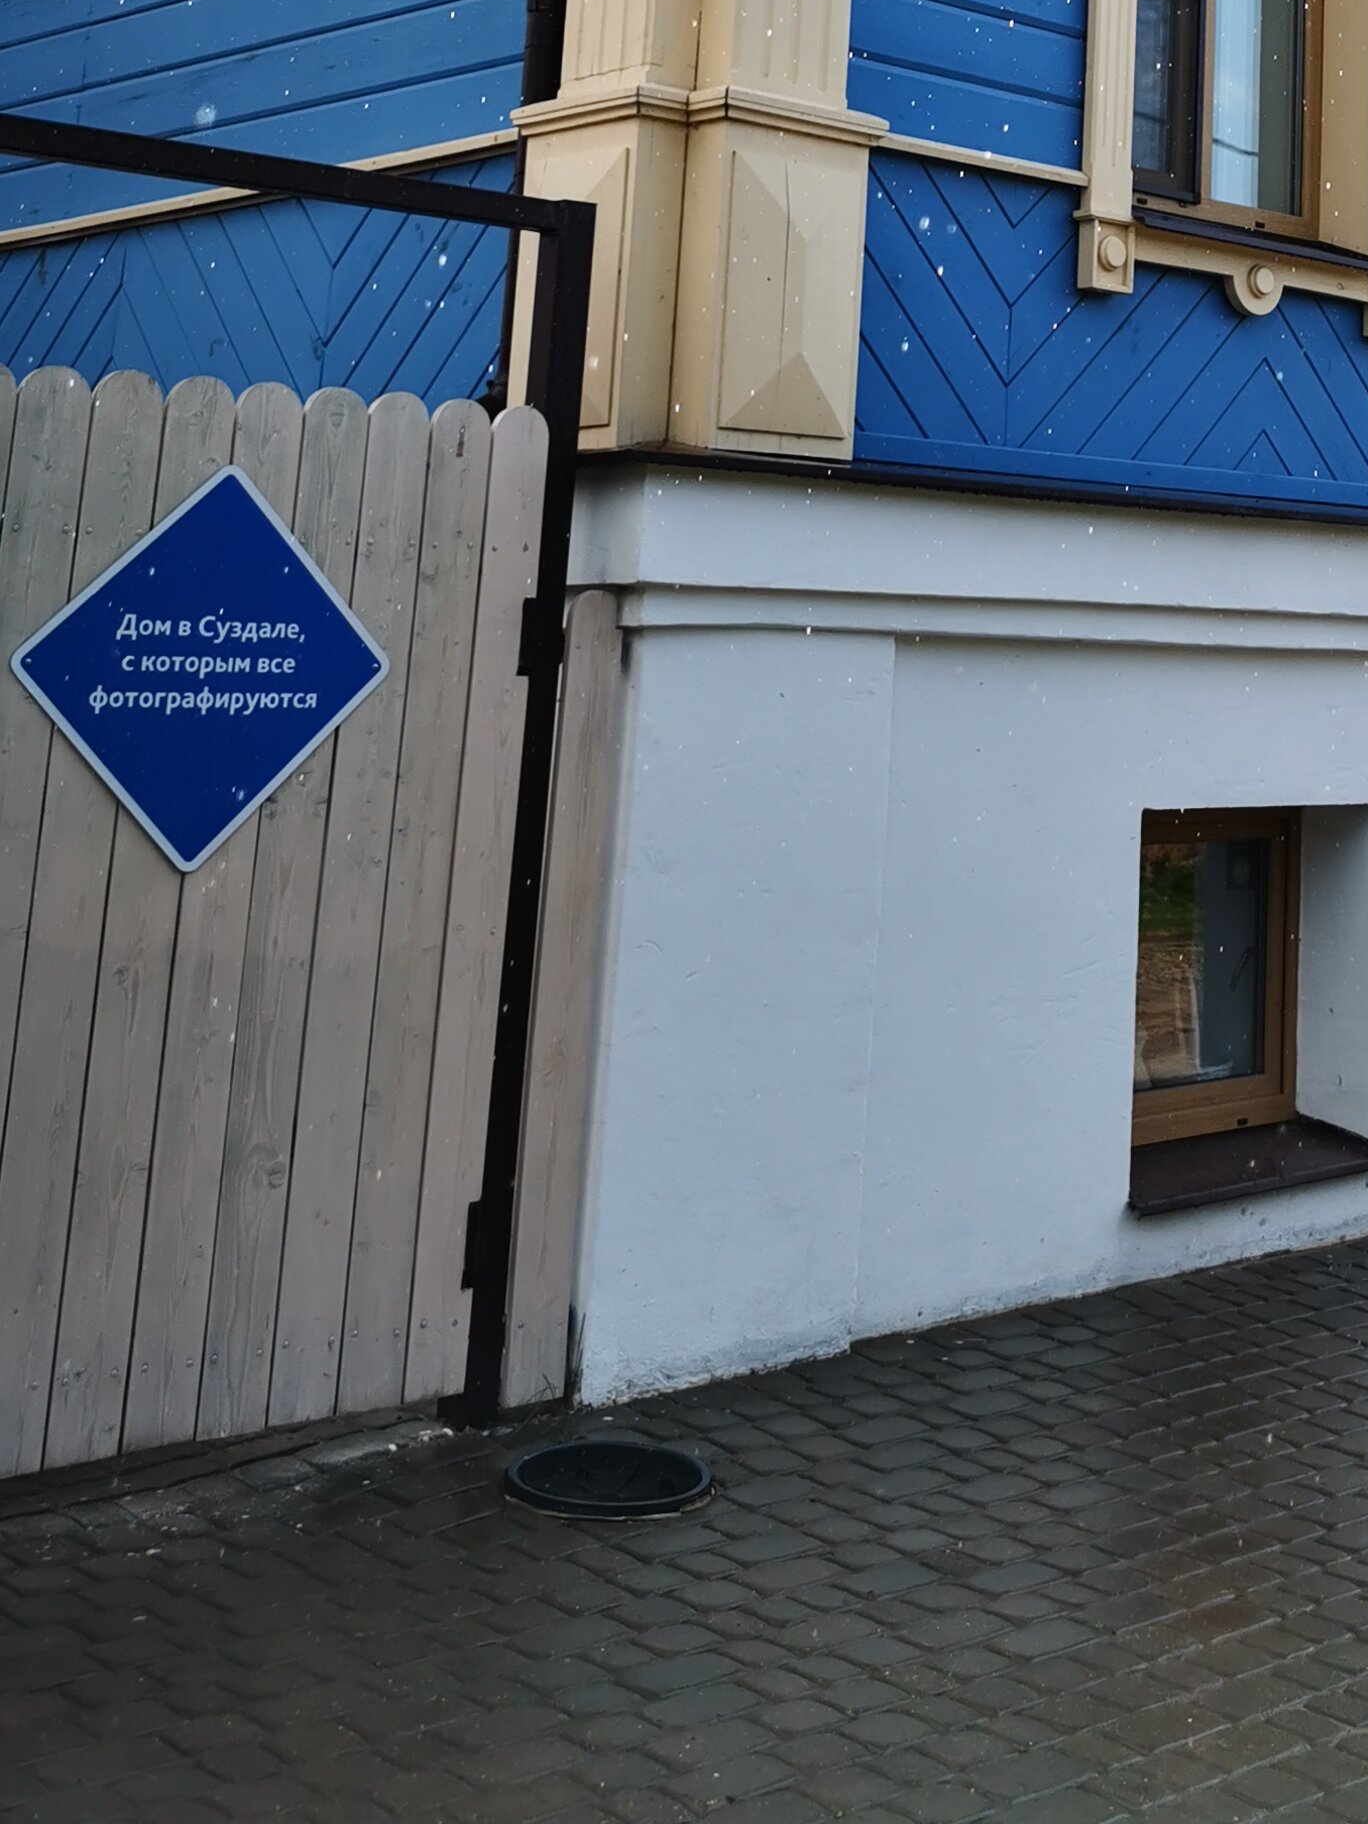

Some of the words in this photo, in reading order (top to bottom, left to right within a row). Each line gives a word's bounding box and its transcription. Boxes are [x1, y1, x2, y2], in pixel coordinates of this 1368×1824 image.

[116, 614, 171, 640] Дом
[177, 619, 192, 637] в
[199, 616, 306, 643] Суздале,
[121, 654, 134, 672] с
[141, 655, 251, 678] которым
[257, 656, 296, 674] все
[89, 685, 318, 715] фотографируются
